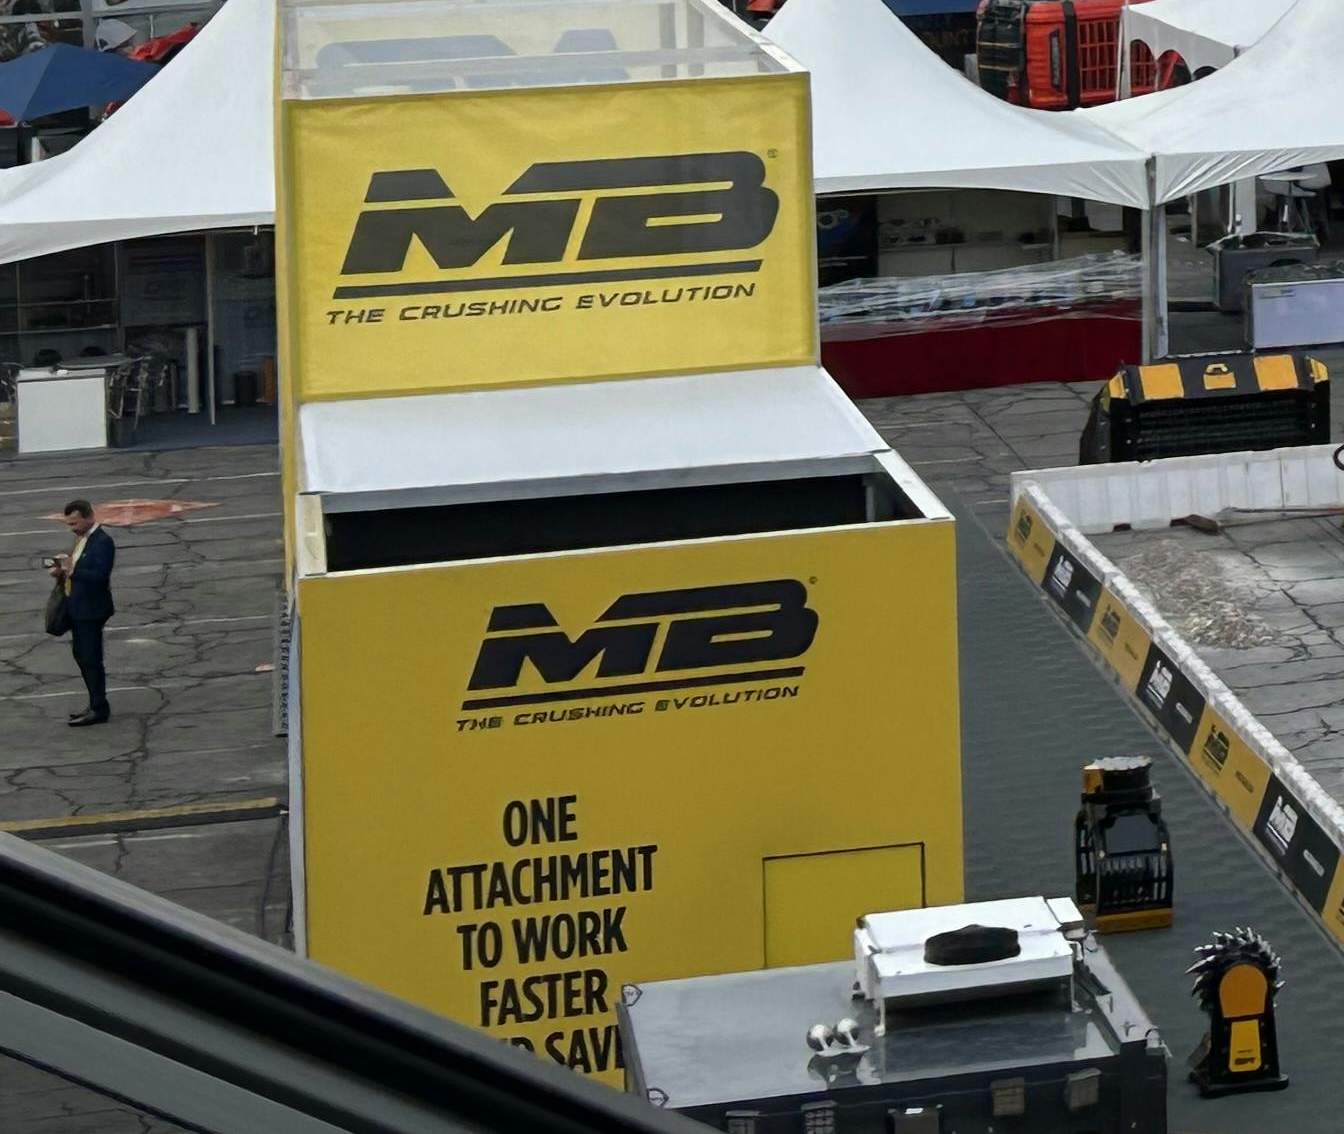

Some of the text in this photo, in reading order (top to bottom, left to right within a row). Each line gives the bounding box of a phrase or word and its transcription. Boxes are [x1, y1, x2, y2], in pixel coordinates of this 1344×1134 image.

[340, 150, 780, 276] MB
[326, 283, 756, 325] THE CRUSHING EVOLUTION
[467, 578, 819, 691] MB
[456, 685, 799, 732] THE CRUSHING EVOLUTION
[503, 794, 578, 847] ONE
[423, 844, 658, 916] ATTACHMENT
[457, 906, 629, 971] TO WORK
[480, 968, 608, 1027] FASTER
